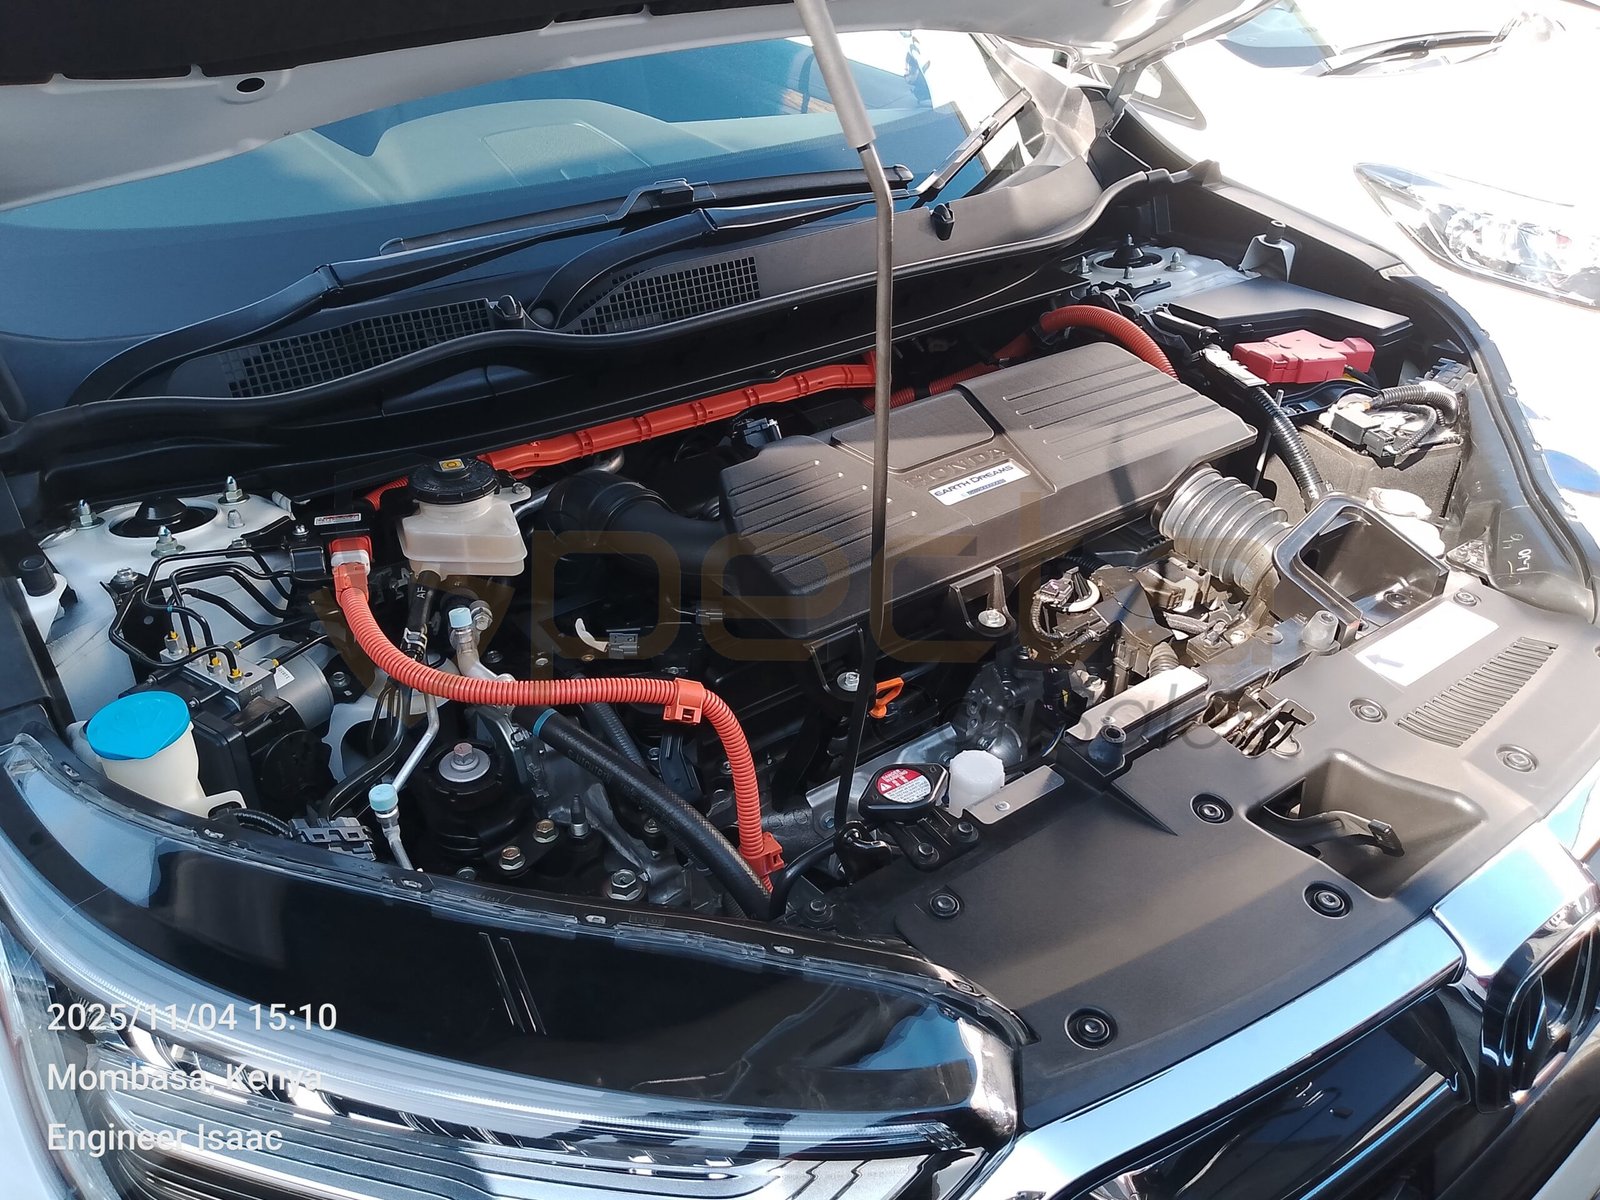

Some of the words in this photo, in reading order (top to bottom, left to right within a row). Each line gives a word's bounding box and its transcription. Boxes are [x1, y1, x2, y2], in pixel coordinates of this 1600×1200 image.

[902, 449, 1013, 489] HONDA
[934, 480, 970, 497] EARTH
[970, 465, 1014, 484] DREAMS
